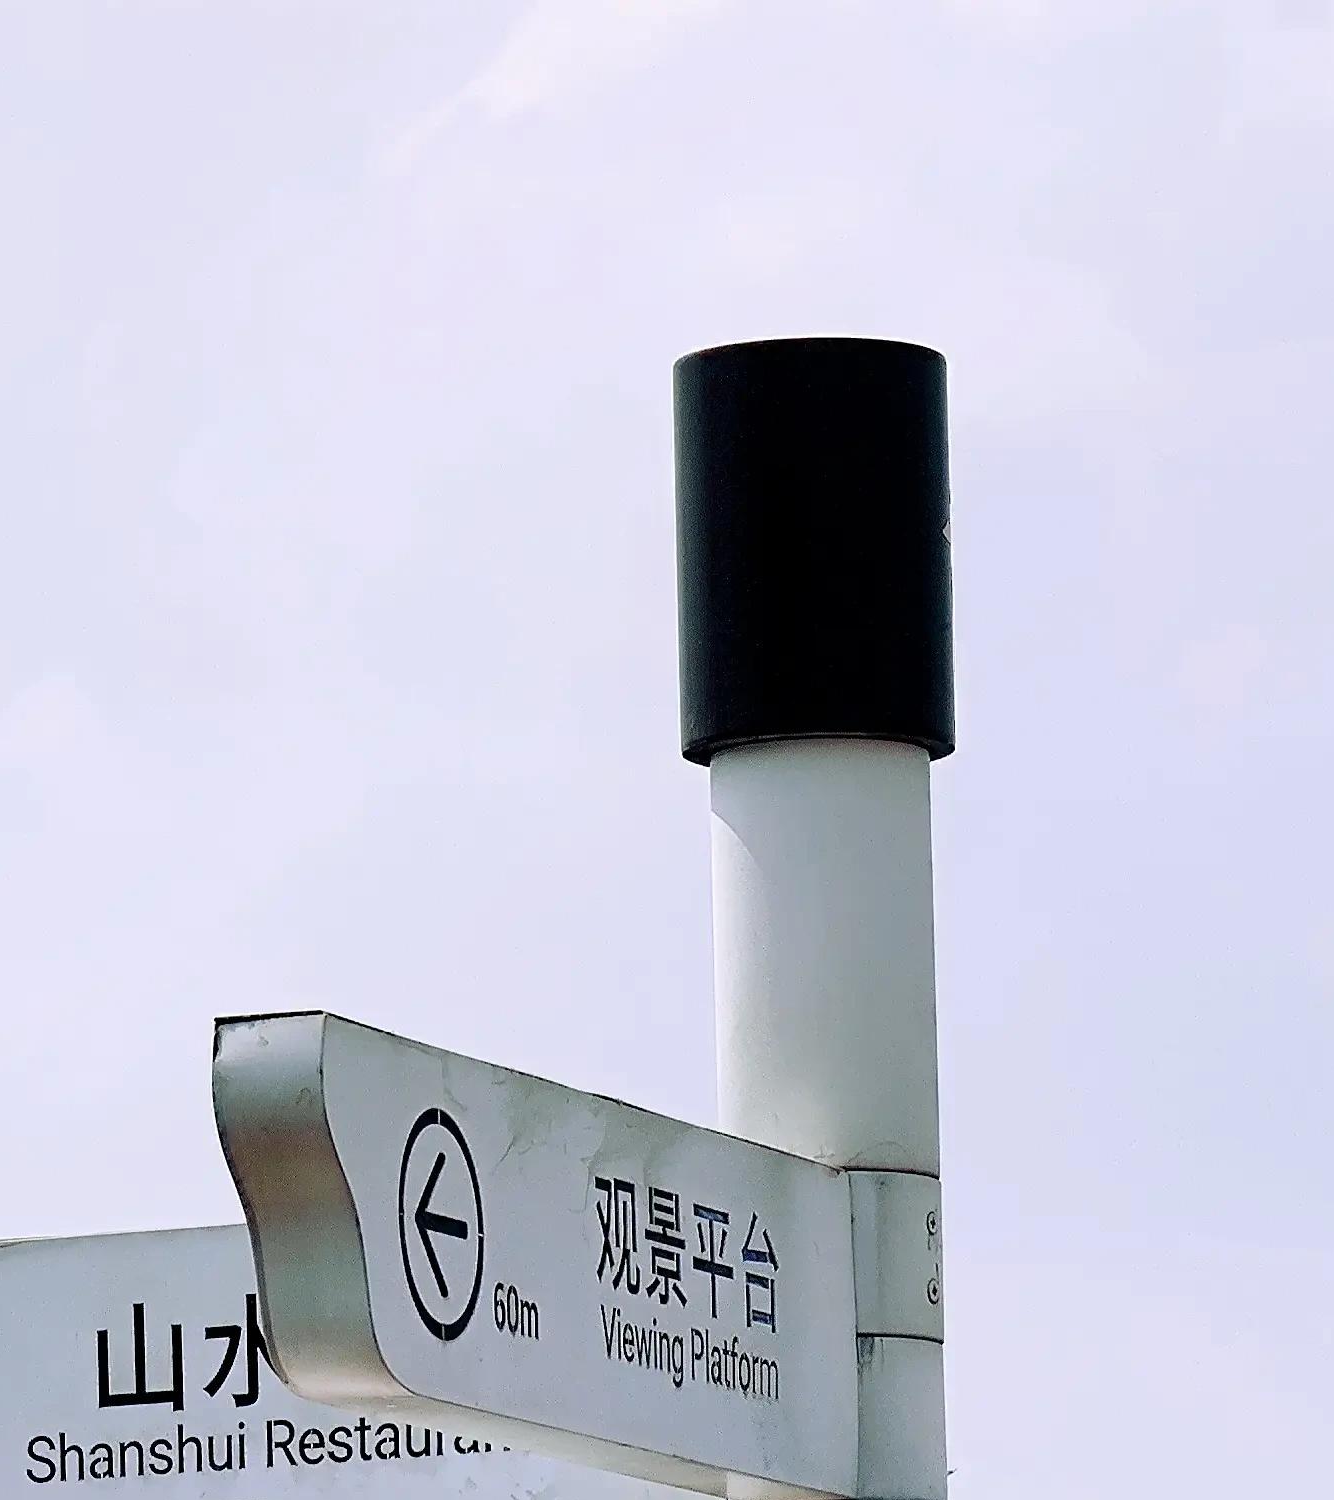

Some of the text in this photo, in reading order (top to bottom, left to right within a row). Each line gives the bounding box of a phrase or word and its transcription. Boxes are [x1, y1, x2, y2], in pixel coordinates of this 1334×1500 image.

[595, 1176, 779, 1334] 观景平台
[494, 1281, 540, 1340] 60m
[600, 1304, 779, 1400] Viewing Platform
[26, 1416, 511, 1484] Shanshui Restaur
